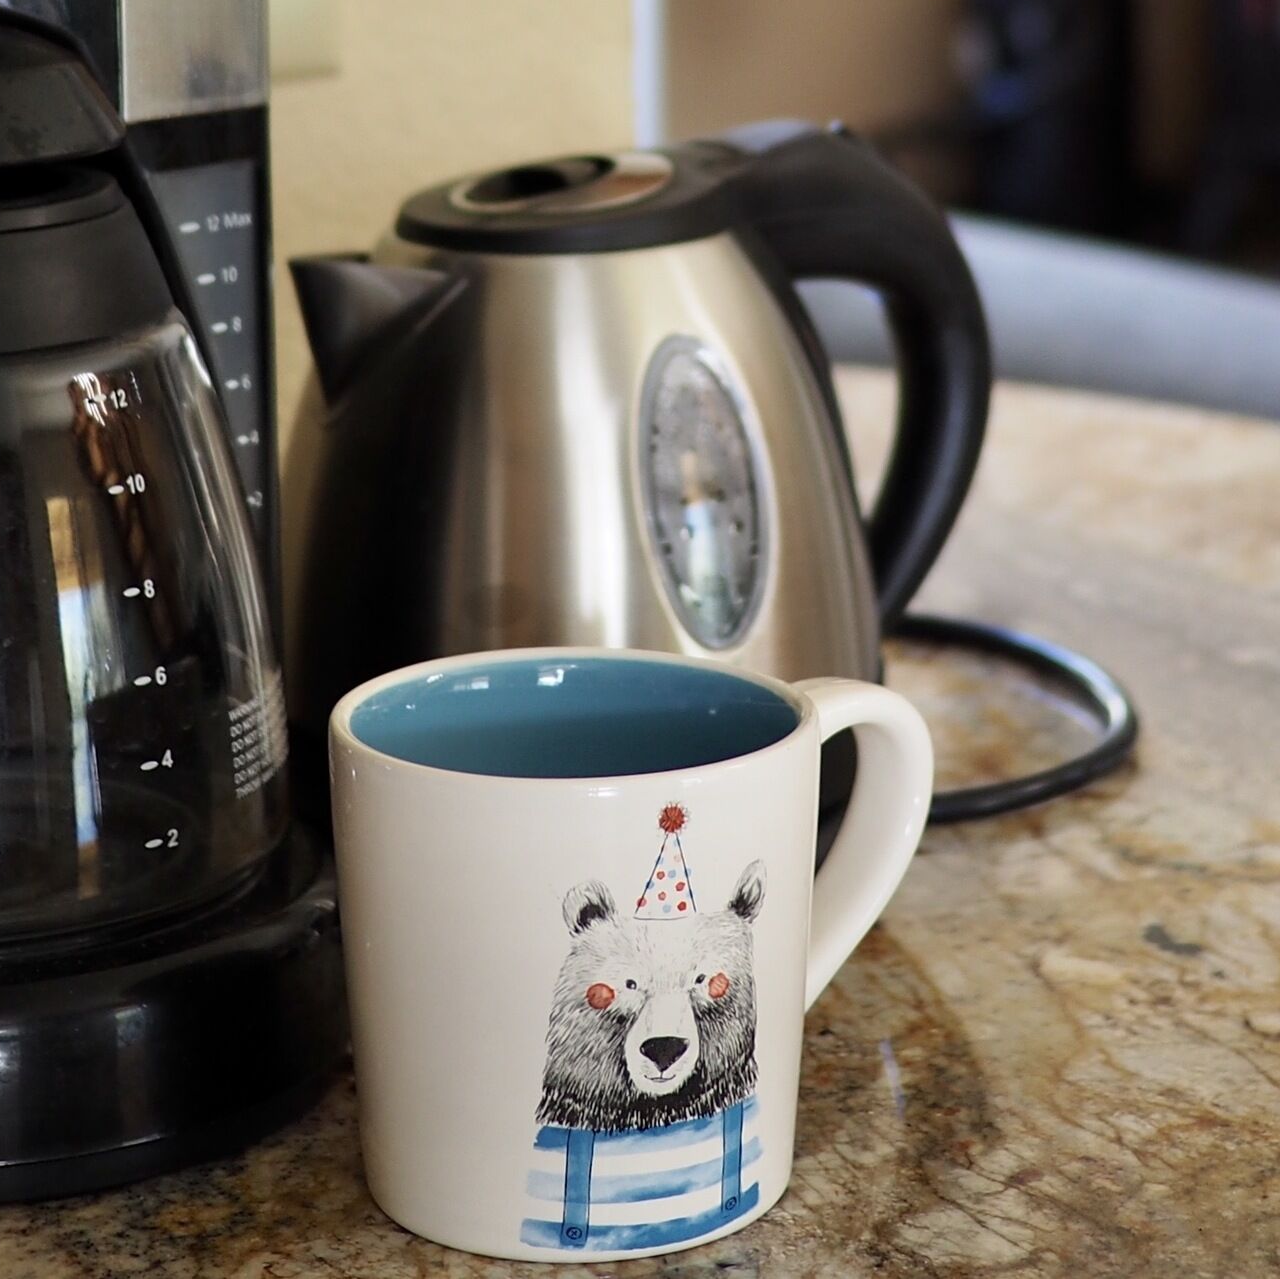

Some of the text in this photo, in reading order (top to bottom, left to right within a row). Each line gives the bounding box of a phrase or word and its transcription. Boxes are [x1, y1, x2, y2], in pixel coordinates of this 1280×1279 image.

[207, 211, 252, 232] 12 Max
[222, 267, 238, 283] 10
[231, 316, 242, 333] 8
[109, 387, 129, 410] 12
[126, 472, 146, 495] 10
[143, 578, 155, 599] 8
[154, 665, 167, 686] 6
[161, 748, 174, 768] 4
[167, 827, 179, 848] 2
